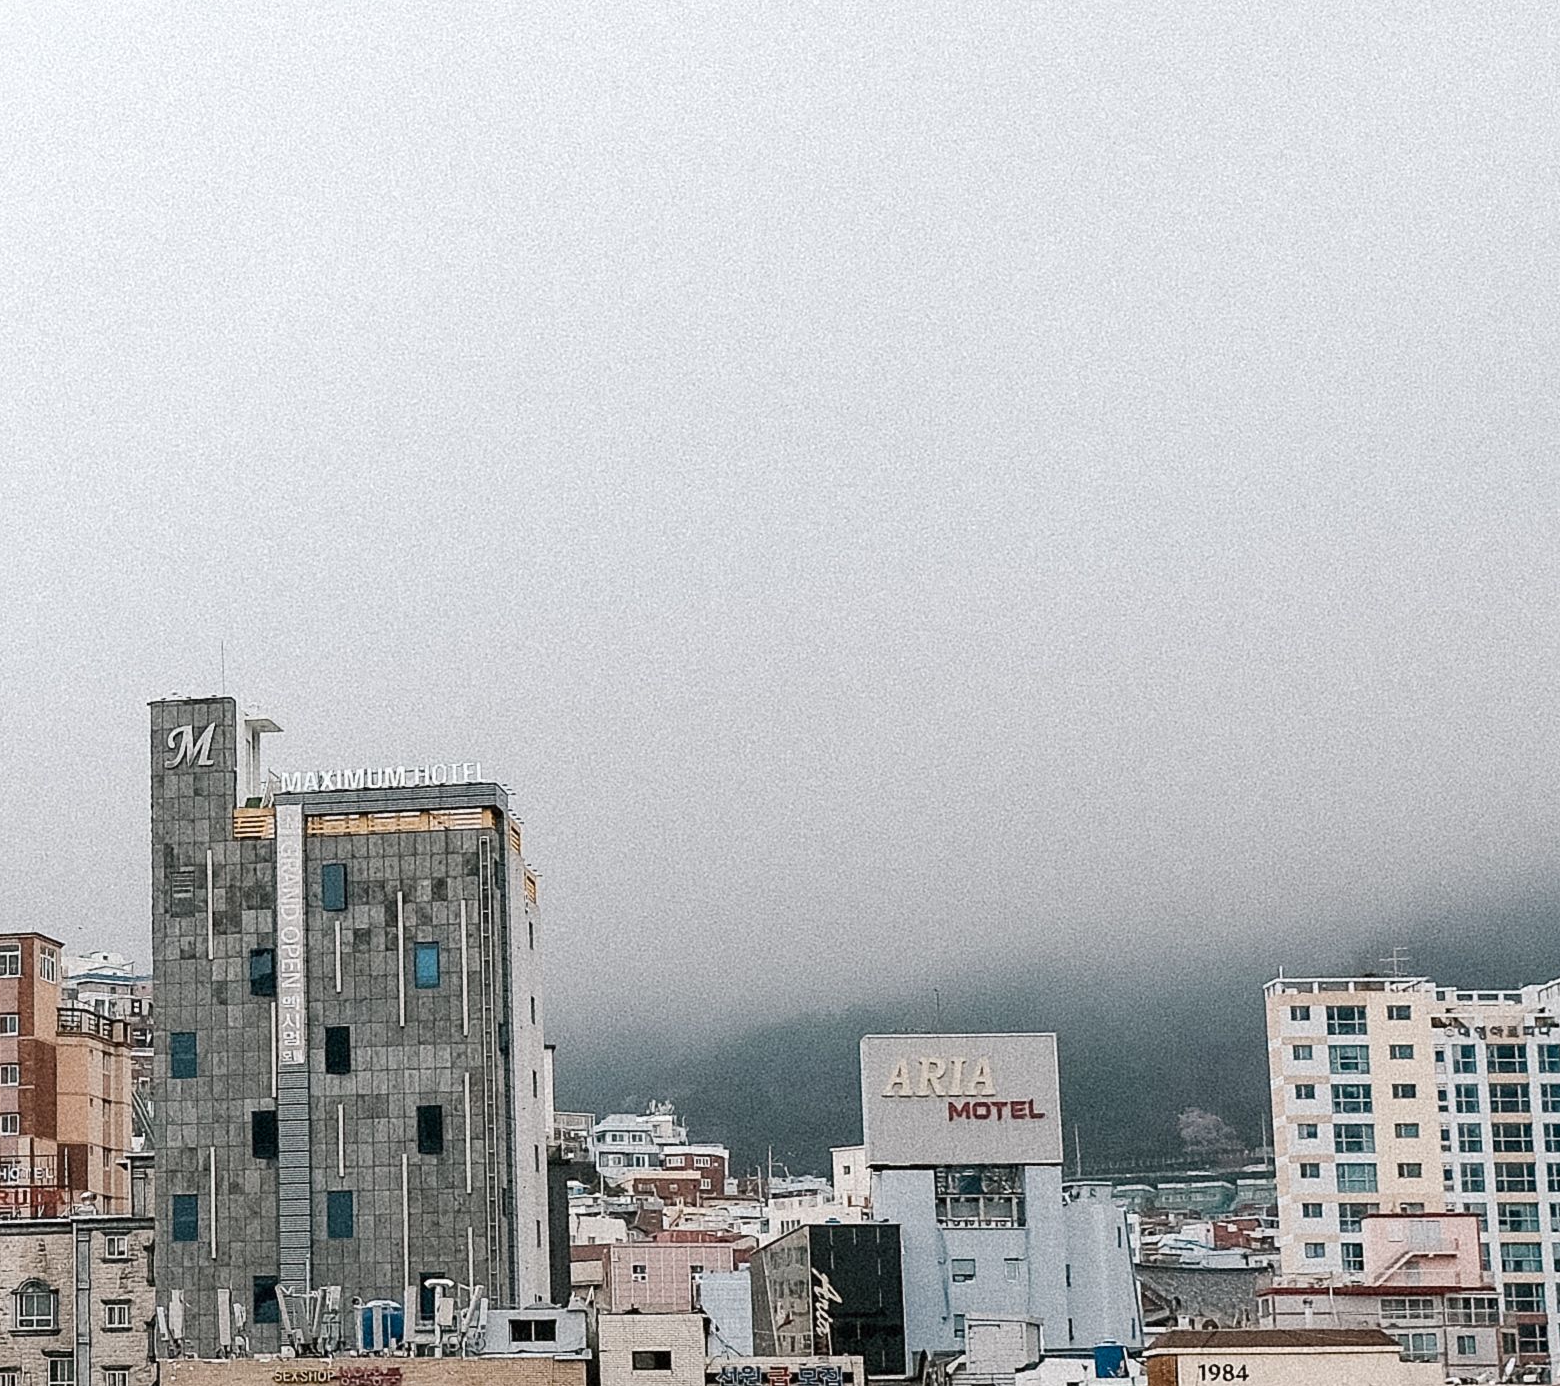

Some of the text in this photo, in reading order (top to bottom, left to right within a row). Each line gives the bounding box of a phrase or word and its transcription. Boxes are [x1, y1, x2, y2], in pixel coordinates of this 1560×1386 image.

[165, 722, 218, 769] M
[280, 763, 483, 792] MAXIMUM HOTEL
[280, 925, 302, 990] OPEN
[881, 1057, 997, 1098] ARIA
[947, 1100, 1046, 1122] MOTEL
[1197, 1363, 1250, 1382] 1984
